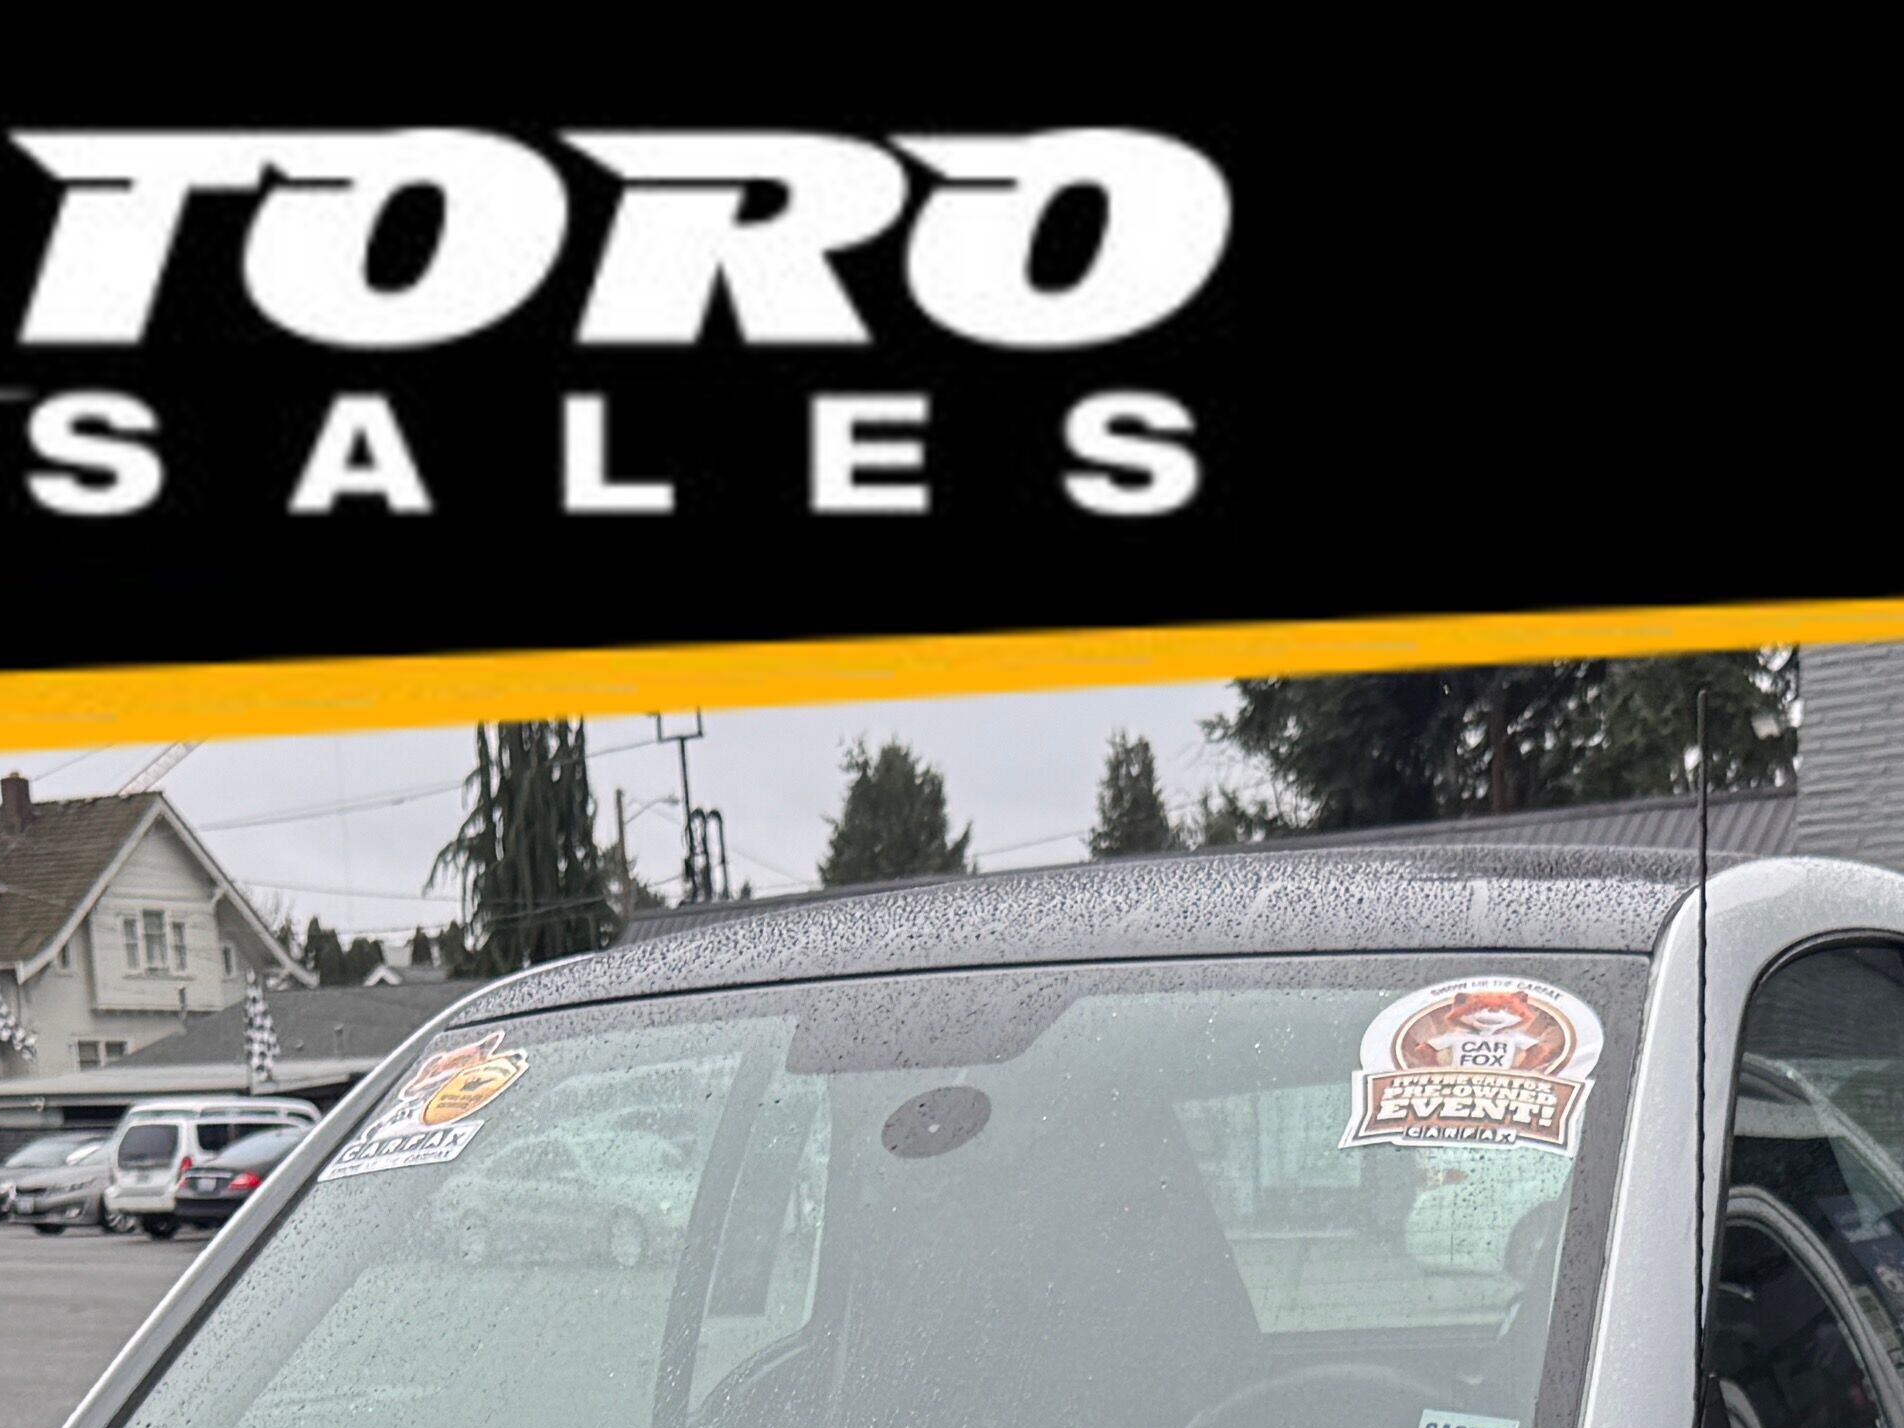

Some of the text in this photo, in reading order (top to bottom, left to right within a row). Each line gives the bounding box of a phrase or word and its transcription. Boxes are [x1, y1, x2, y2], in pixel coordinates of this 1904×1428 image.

[1461, 1040, 1508, 1054] CAR
[1460, 1053, 1505, 1067] FOX
[1382, 1084, 1558, 1106] PRE-OWNED
[1376, 1096, 1556, 1127] EVENT!
[1407, 1127, 1514, 1143] CARFAX
[341, 1129, 466, 1162] CARFAX
